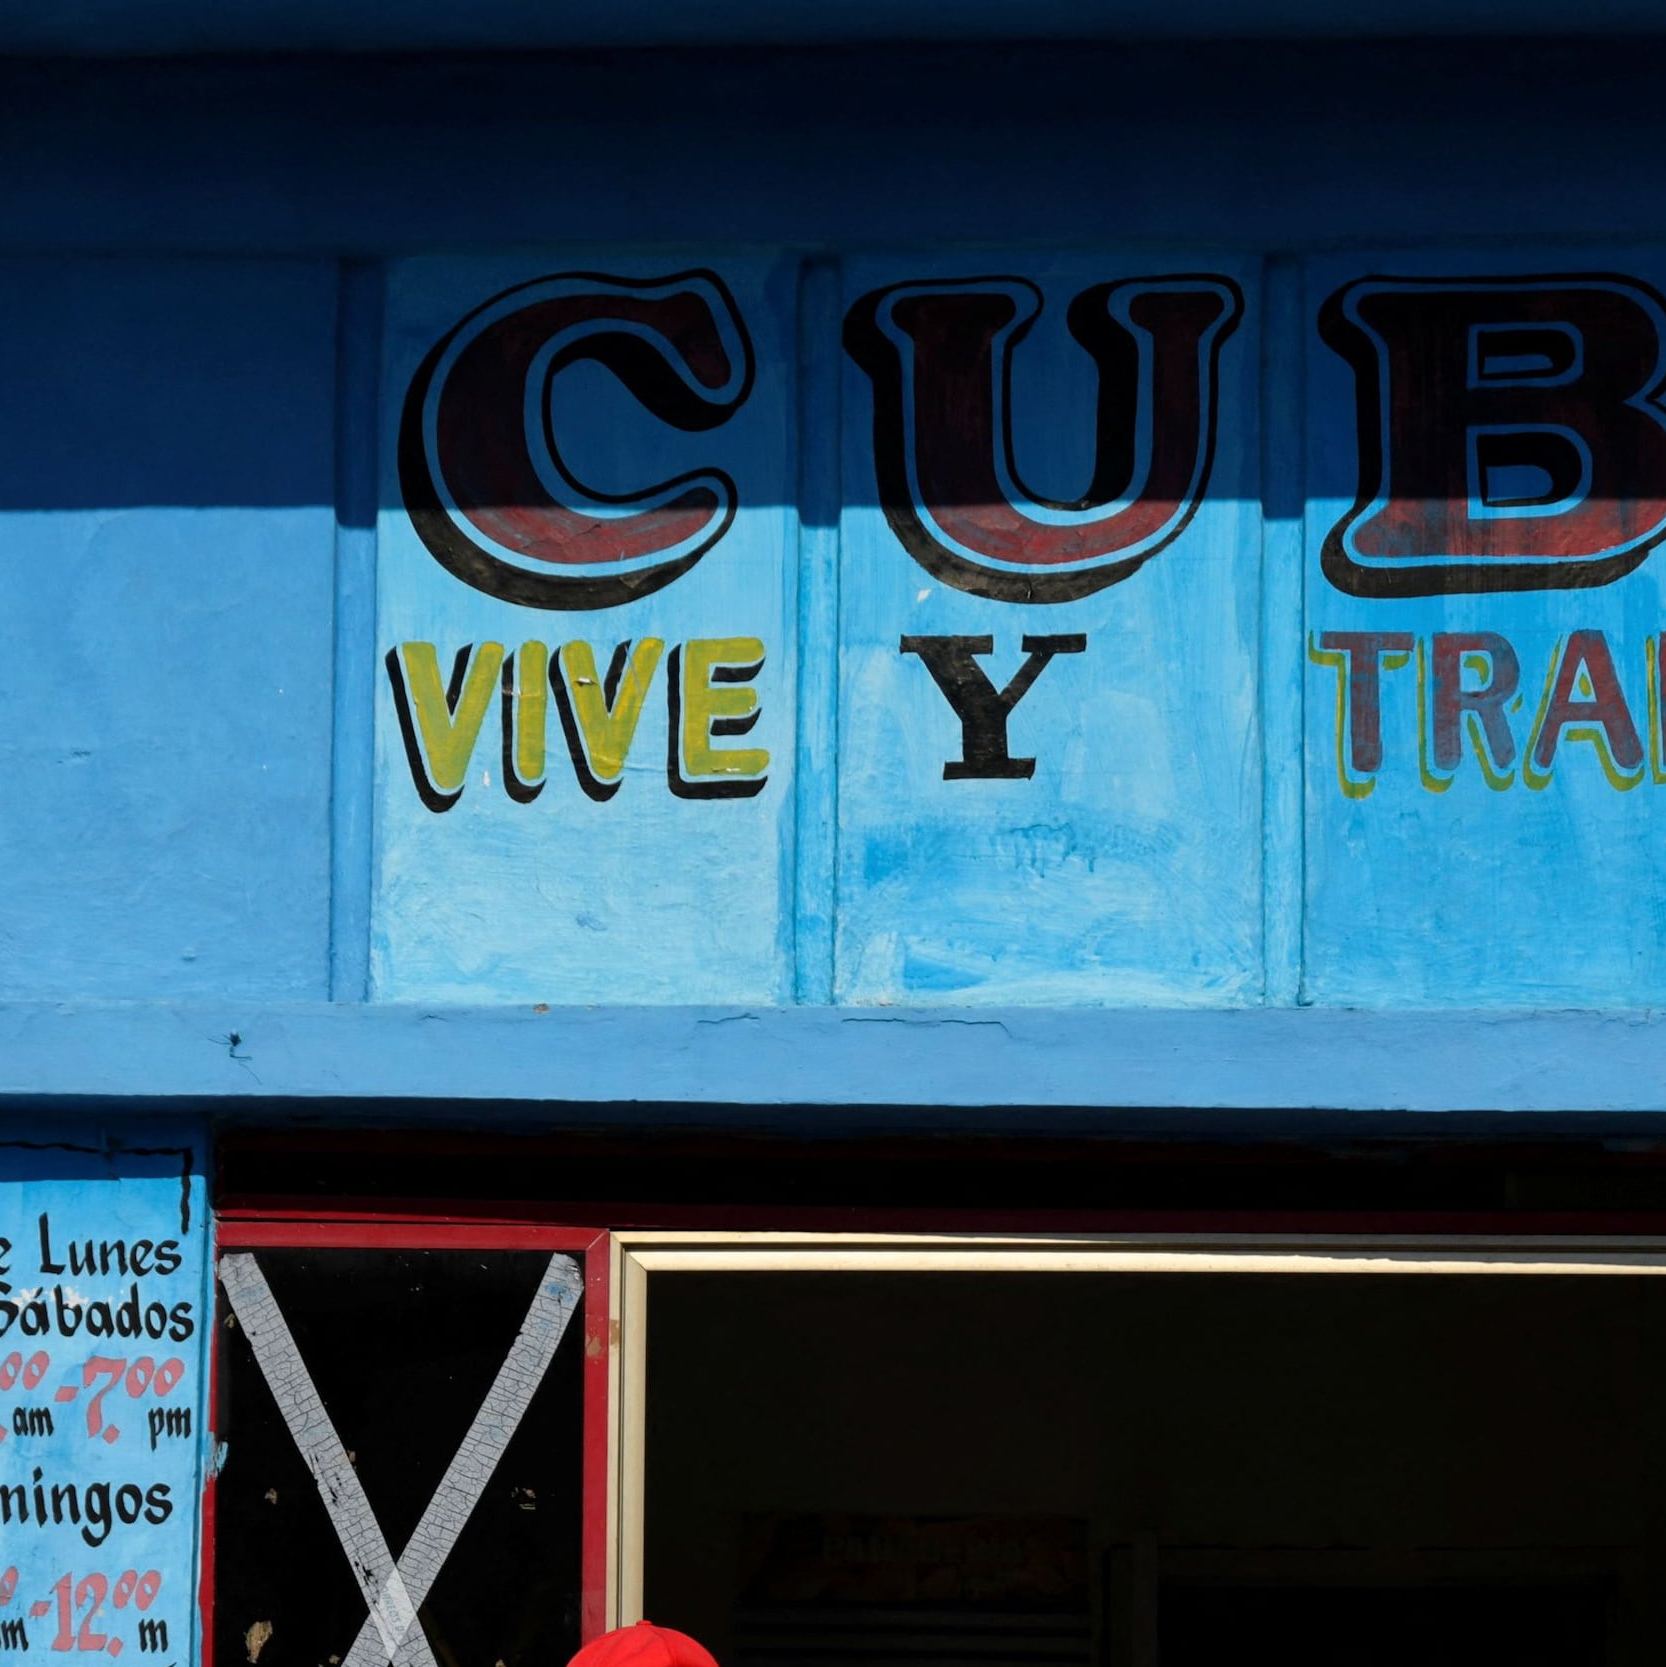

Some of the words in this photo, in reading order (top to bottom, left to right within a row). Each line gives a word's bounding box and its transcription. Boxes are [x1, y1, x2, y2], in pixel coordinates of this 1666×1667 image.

[386, 635, 769, 812] VIVE
[901, 634, 1087, 781] Y
[39, 1212, 182, 1277] Lunes
[12, 1406, 54, 1437] am
[148, 1407, 192, 1452] pm
[138, 1619, 169, 1652] m
